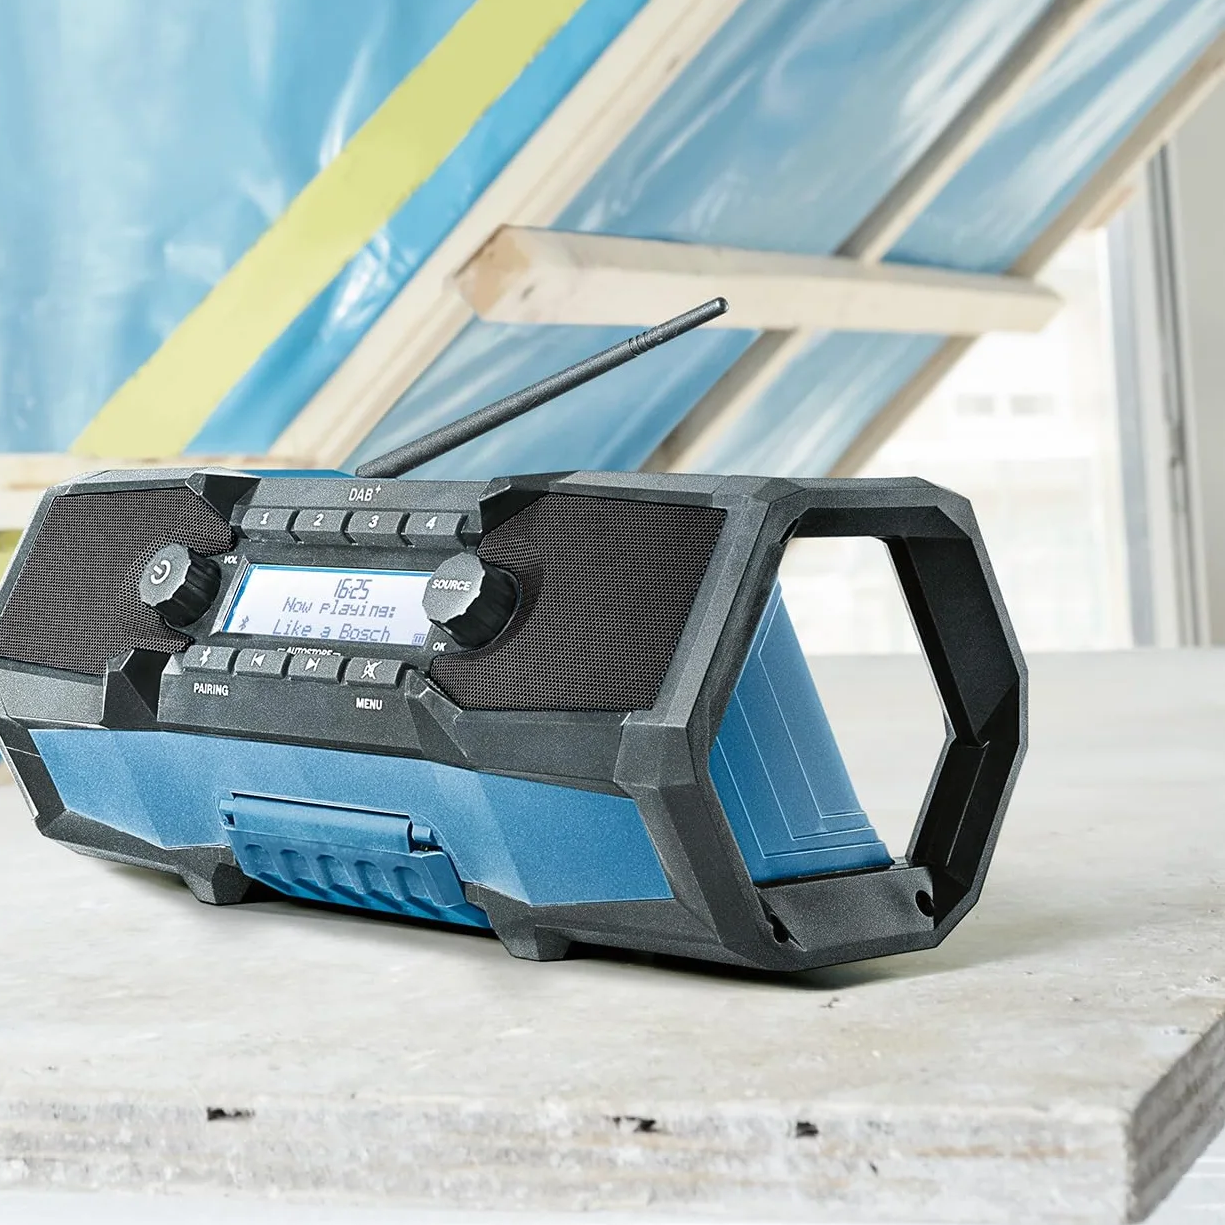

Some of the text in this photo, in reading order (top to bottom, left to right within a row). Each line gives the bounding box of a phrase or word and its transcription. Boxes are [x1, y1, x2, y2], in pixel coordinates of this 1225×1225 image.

[260, 513, 270, 525] 1
[314, 514, 324, 526] 2
[368, 515, 379, 528] 3
[426, 516, 437, 529] 4
[224, 556, 238, 564] VOL
[432, 579, 471, 590] SOURCE
[282, 597, 313, 613] Now
[272, 618, 390, 643] Like a Bosch
[433, 642, 446, 652] OK
[193, 682, 229, 697] PAIRING
[355, 697, 383, 711] MENU
